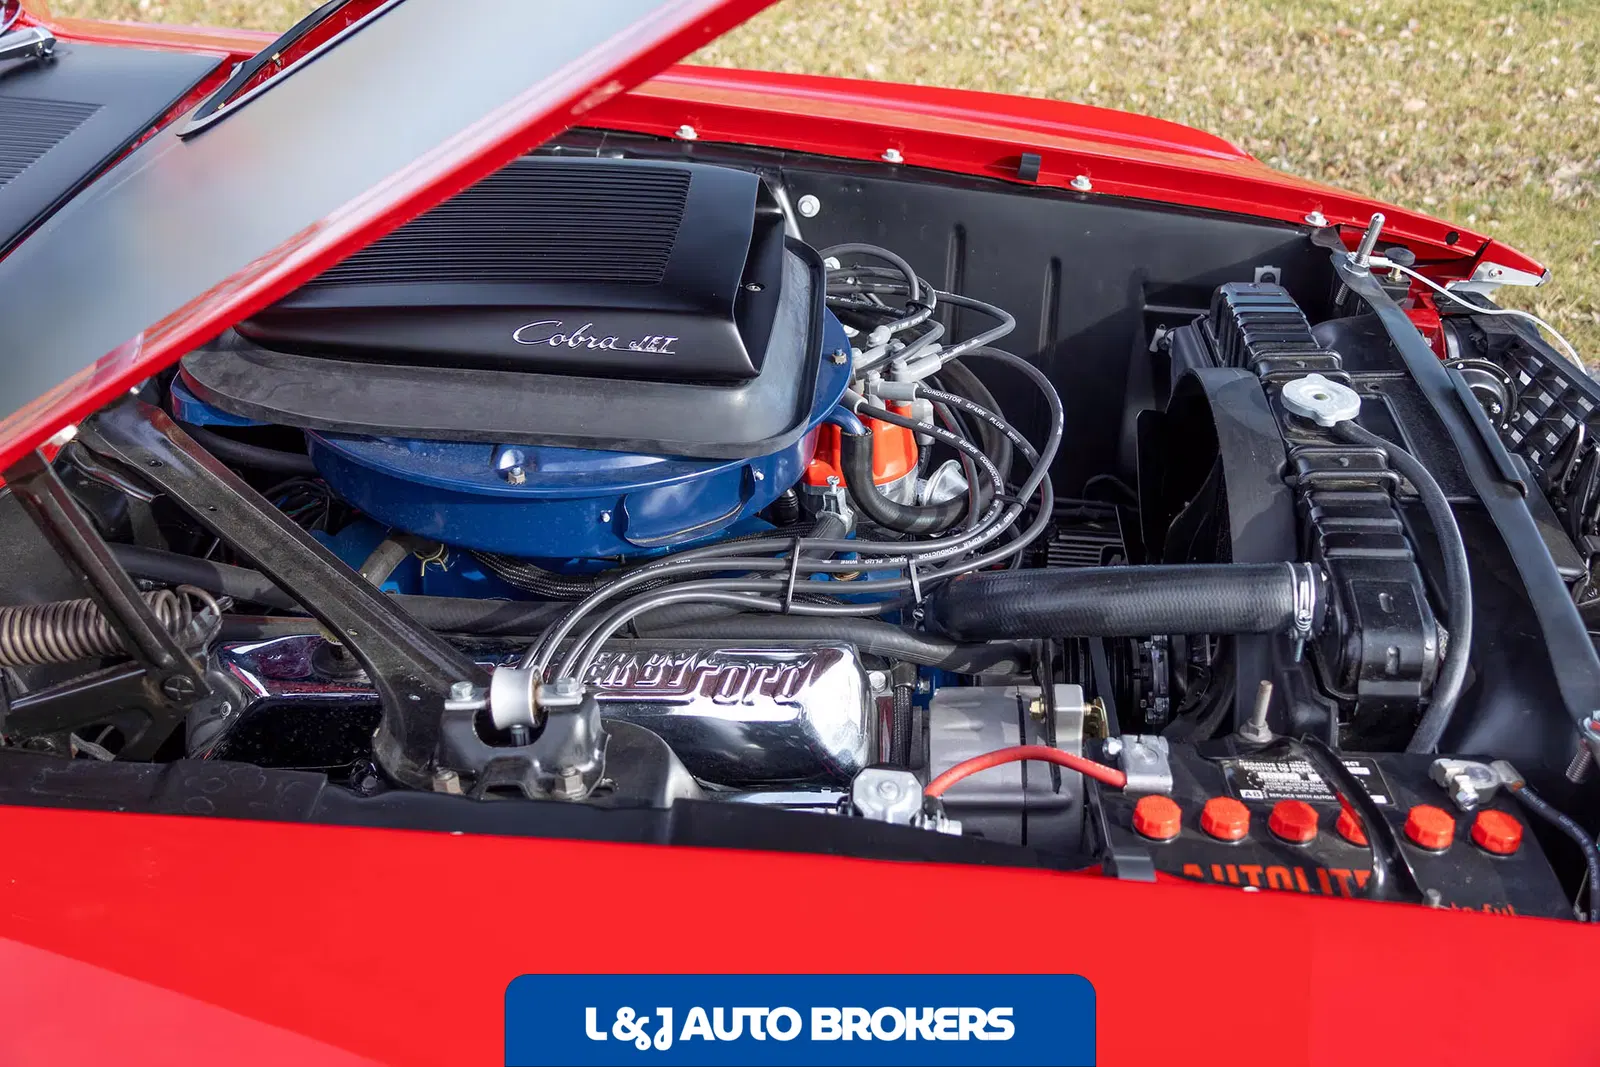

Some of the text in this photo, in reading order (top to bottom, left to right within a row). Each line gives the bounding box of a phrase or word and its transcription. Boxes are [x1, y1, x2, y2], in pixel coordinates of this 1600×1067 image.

[512, 320, 679, 354] Cobra JET
[922, 388, 962, 404] CONDUCTOR
[965, 403, 987, 417] SPARK
[989, 416, 1005, 430] PLUG
[958, 439, 979, 454] SUPER
[979, 455, 1001, 487] CONDUCTOR
[918, 545, 958, 560] CONDUCTOR
